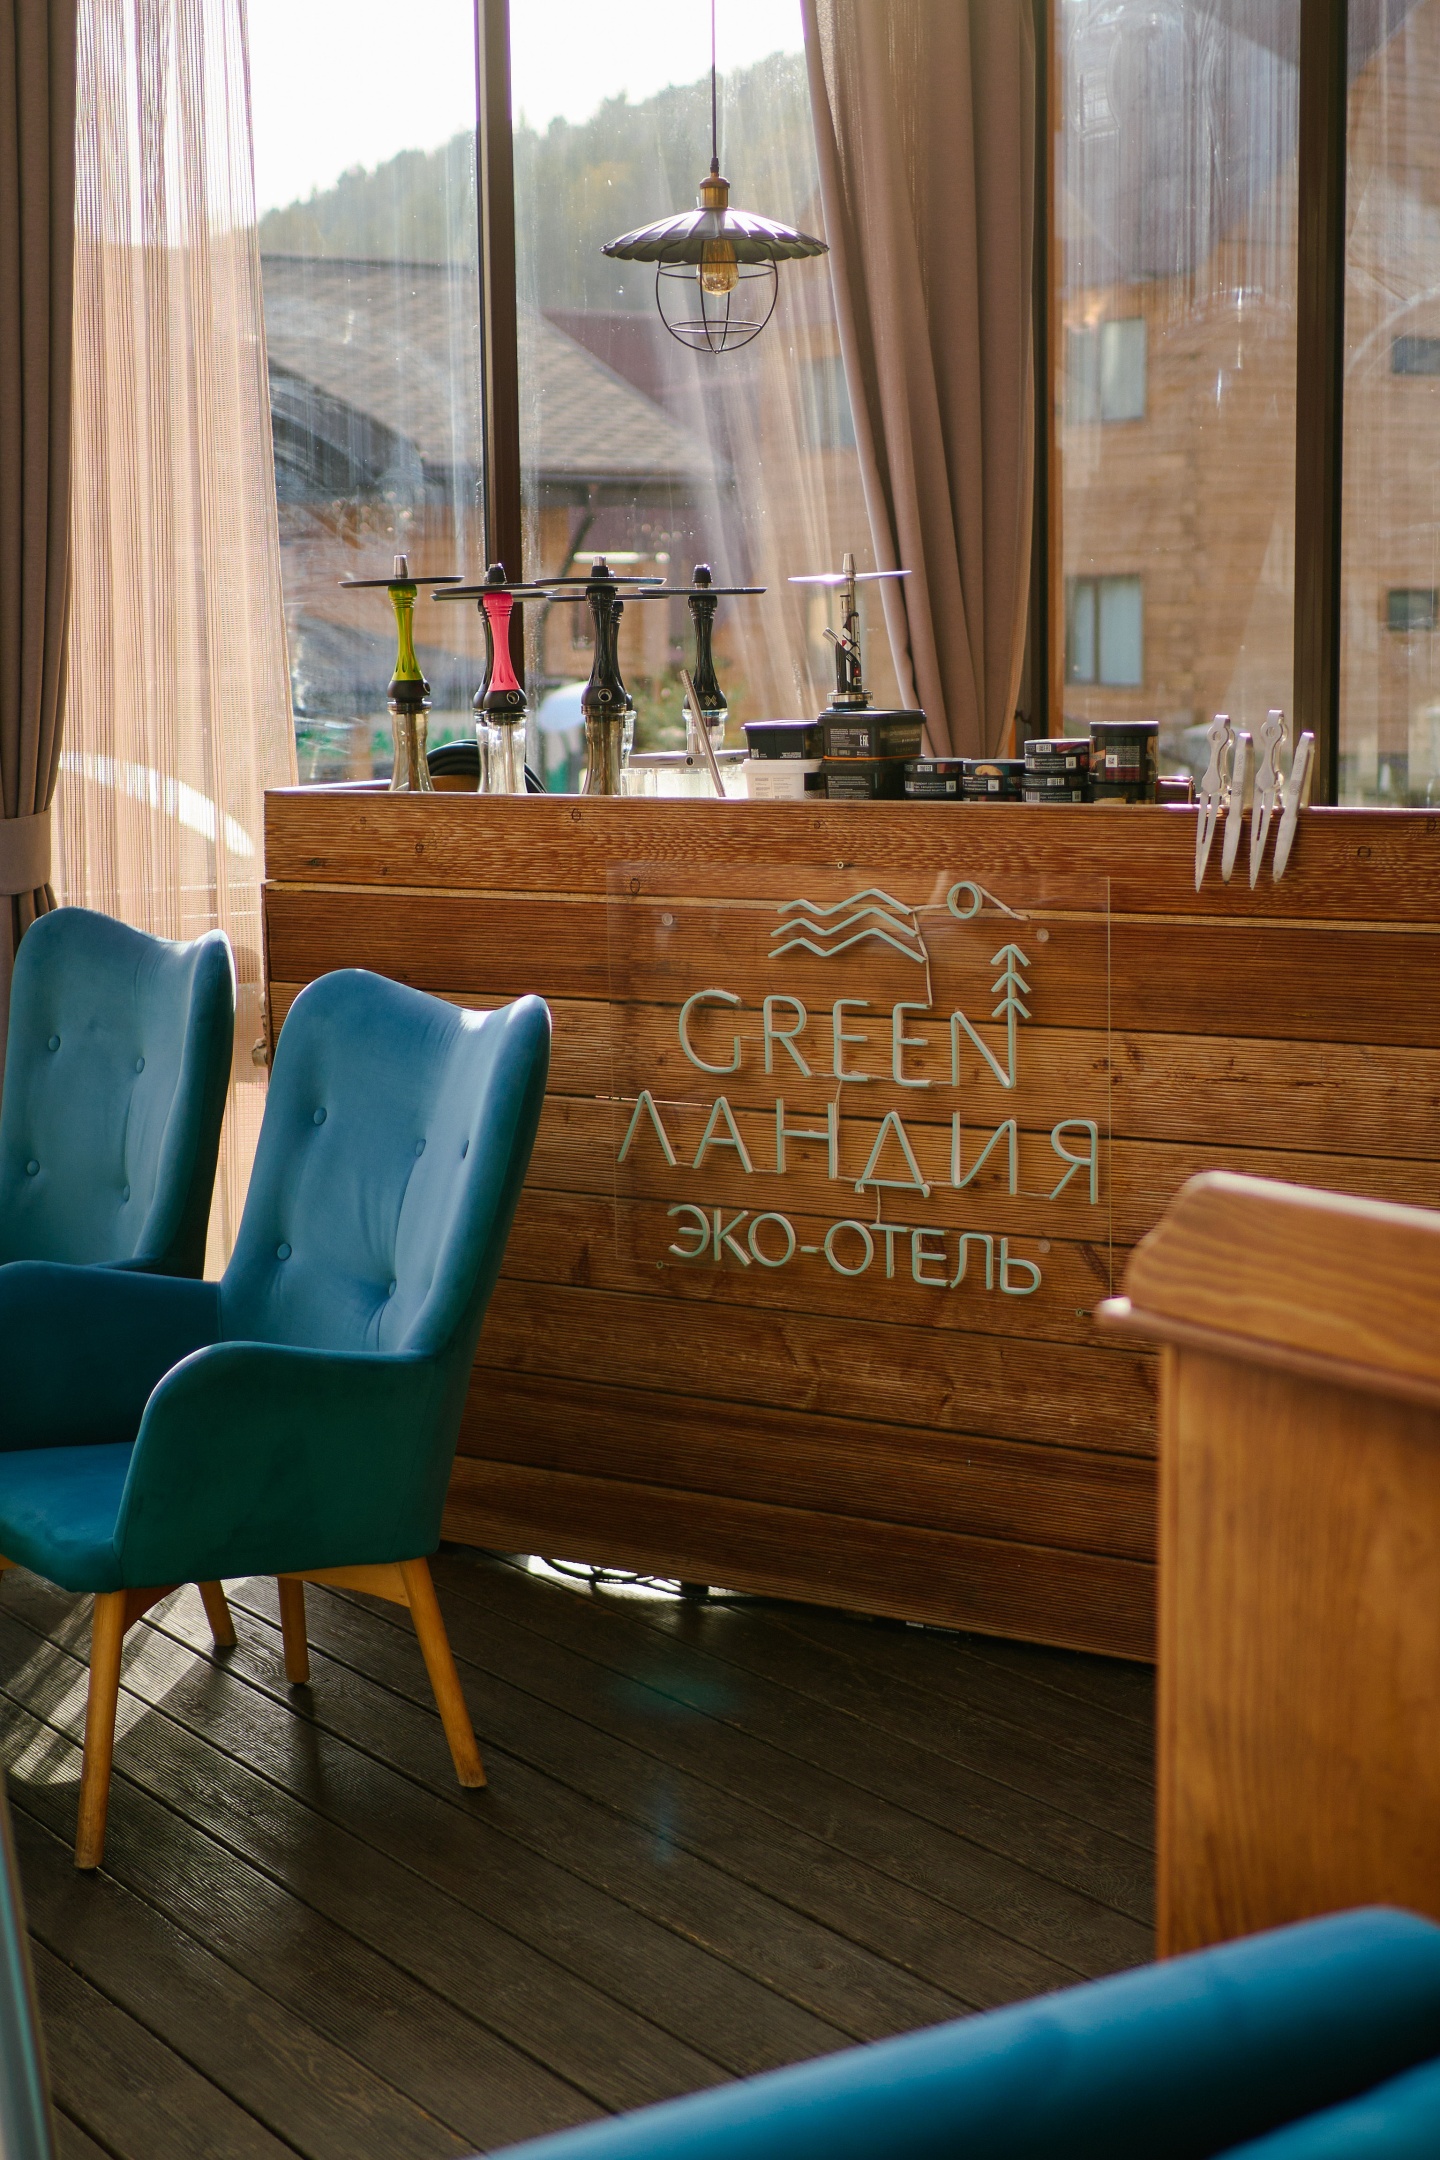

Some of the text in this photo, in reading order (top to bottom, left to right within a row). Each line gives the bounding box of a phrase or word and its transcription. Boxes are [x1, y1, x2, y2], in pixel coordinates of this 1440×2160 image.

[678, 989, 1016, 1088] GREEN
[617, 1090, 1098, 1204] ЛАНДИЯ
[667, 1204, 1041, 1295] ЭКО-ОТЕЛЬ
